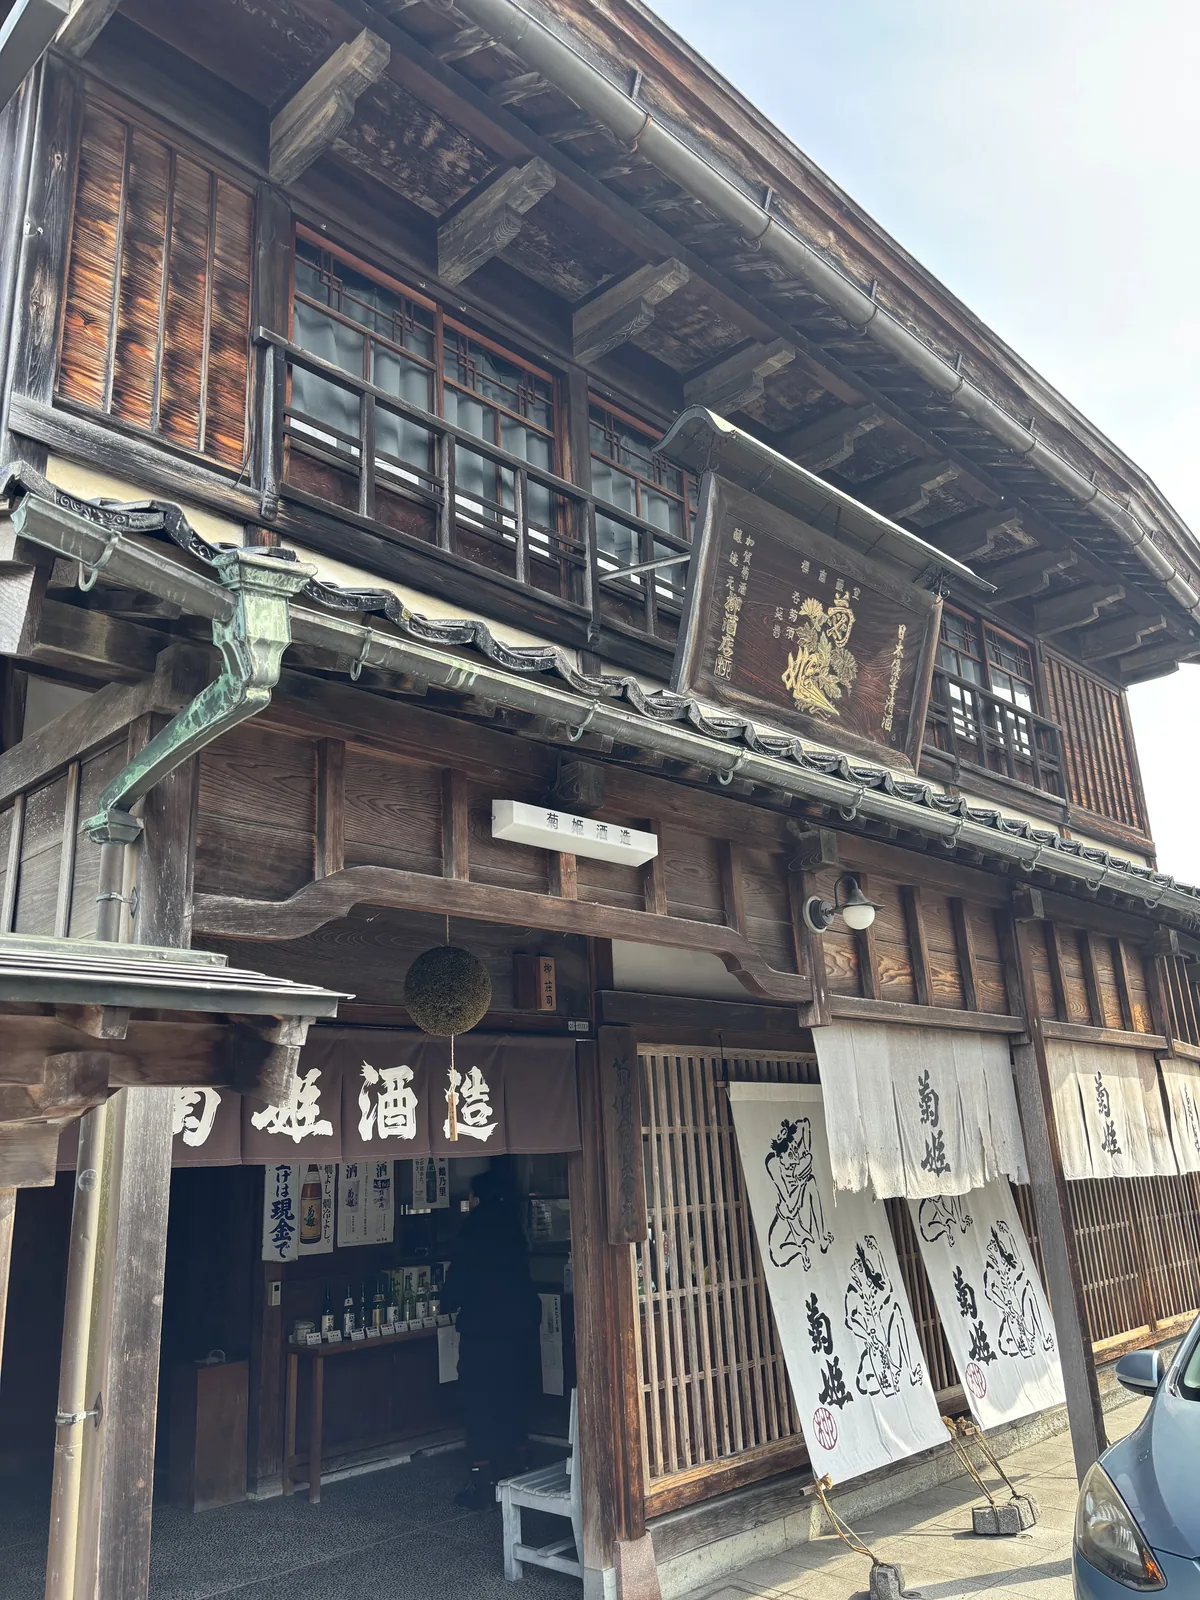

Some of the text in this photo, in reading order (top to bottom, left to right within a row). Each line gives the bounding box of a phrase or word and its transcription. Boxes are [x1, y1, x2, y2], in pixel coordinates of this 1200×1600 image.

[546, 811, 632, 846] 菊姫酒造
[918, 1069, 951, 1178] 菊姫
[1093, 1070, 1123, 1158] 菊姫
[805, 1292, 854, 1411] 菊姫
[952, 1265, 998, 1366] 菊姫
